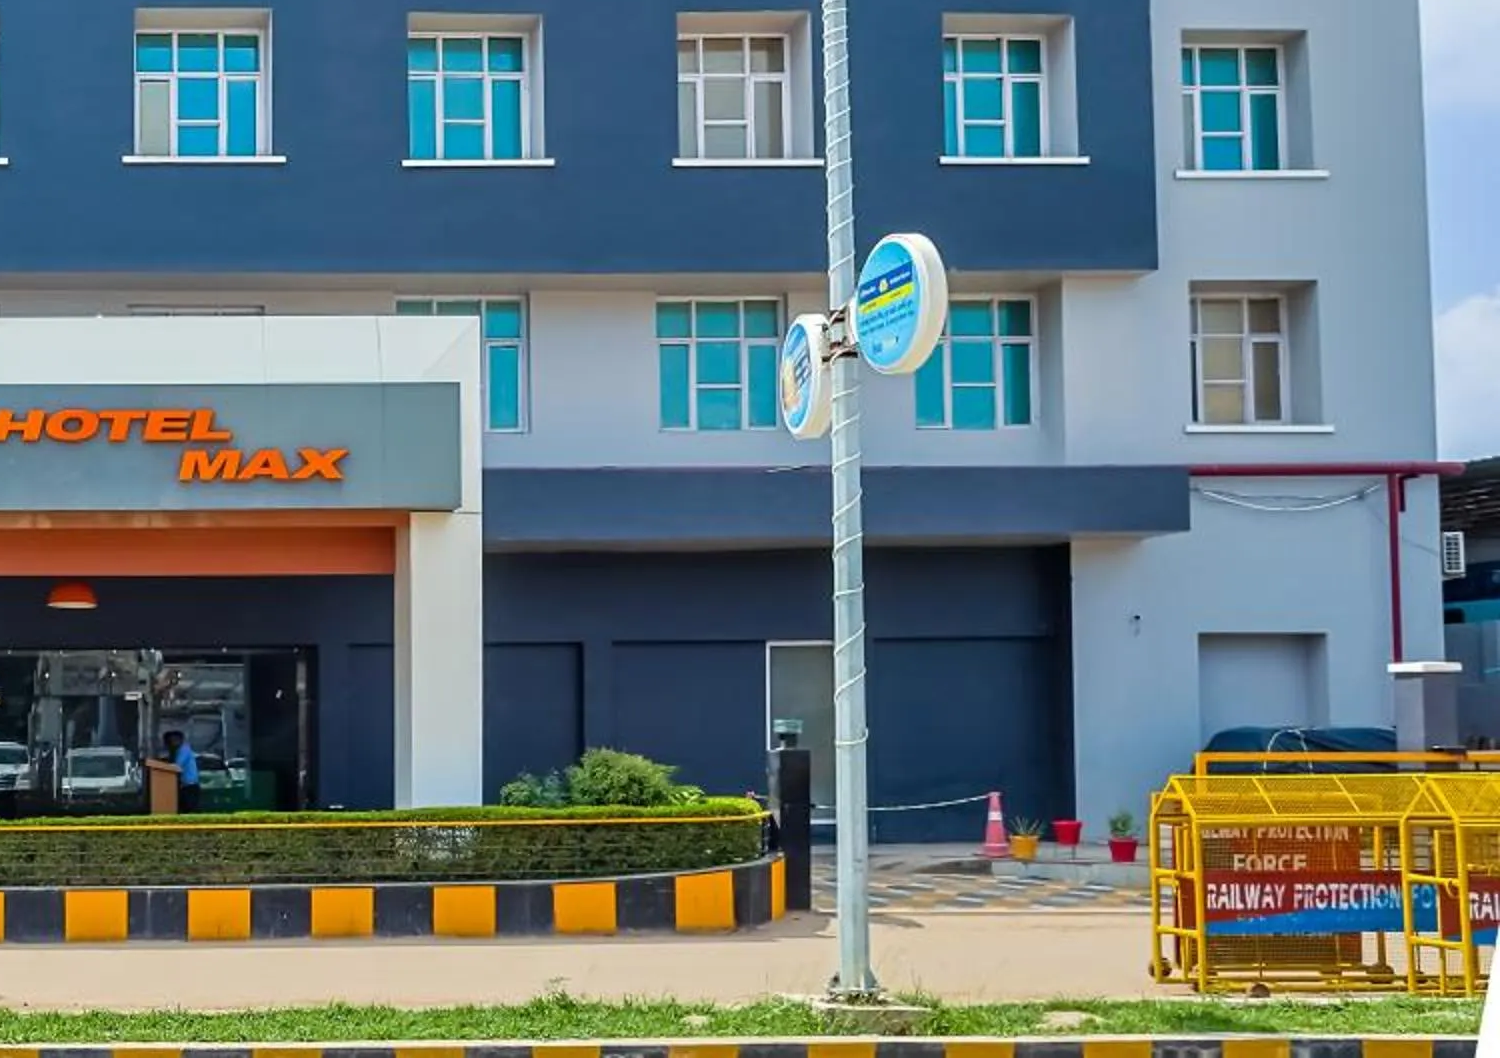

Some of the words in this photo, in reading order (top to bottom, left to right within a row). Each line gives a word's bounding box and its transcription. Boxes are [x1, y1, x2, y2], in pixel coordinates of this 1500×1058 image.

[179, 449, 349, 483] MAX
[1206, 883, 1286, 910] RAILWAY
[1293, 883, 1400, 910] PROTECTION
